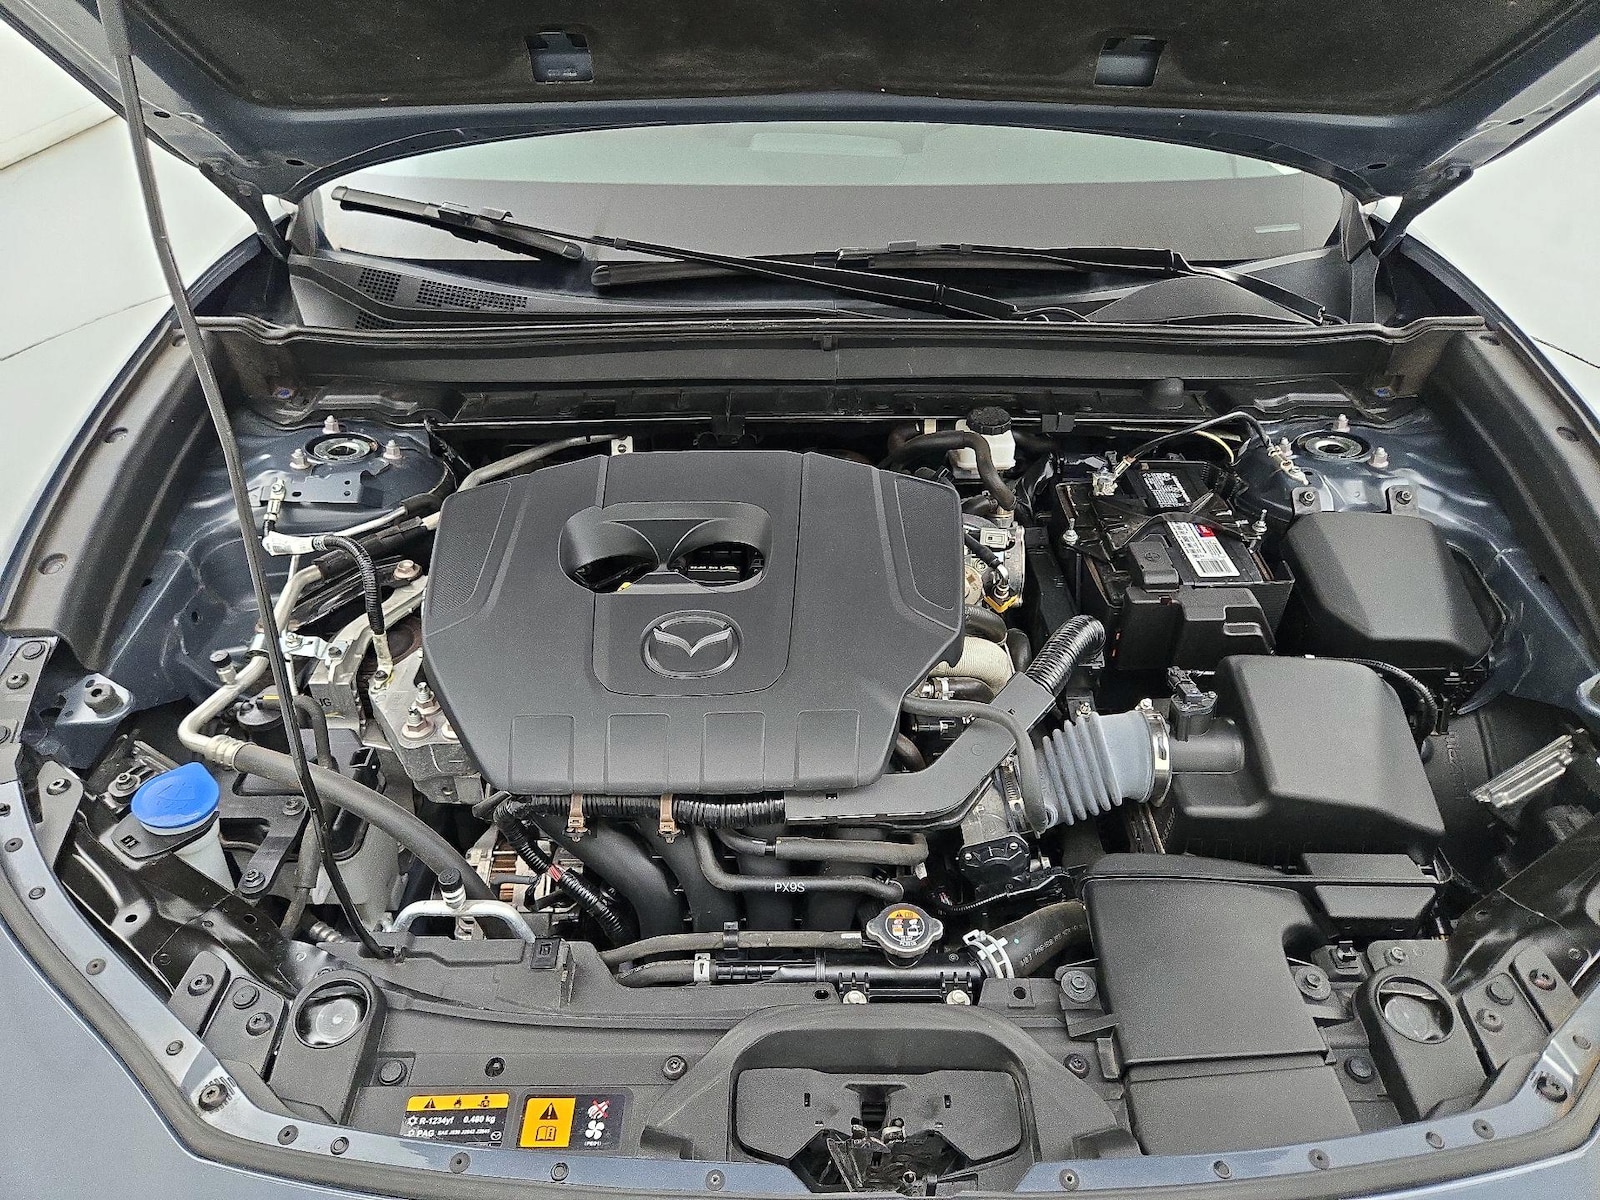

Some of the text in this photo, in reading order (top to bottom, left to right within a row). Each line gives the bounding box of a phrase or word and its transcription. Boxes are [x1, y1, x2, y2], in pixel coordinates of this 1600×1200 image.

[774, 881, 805, 893] PX9S
[419, 1116, 455, 1126] R-1234yf
[485, 1114, 496, 1125] kg
[416, 1129, 435, 1138] PAG
